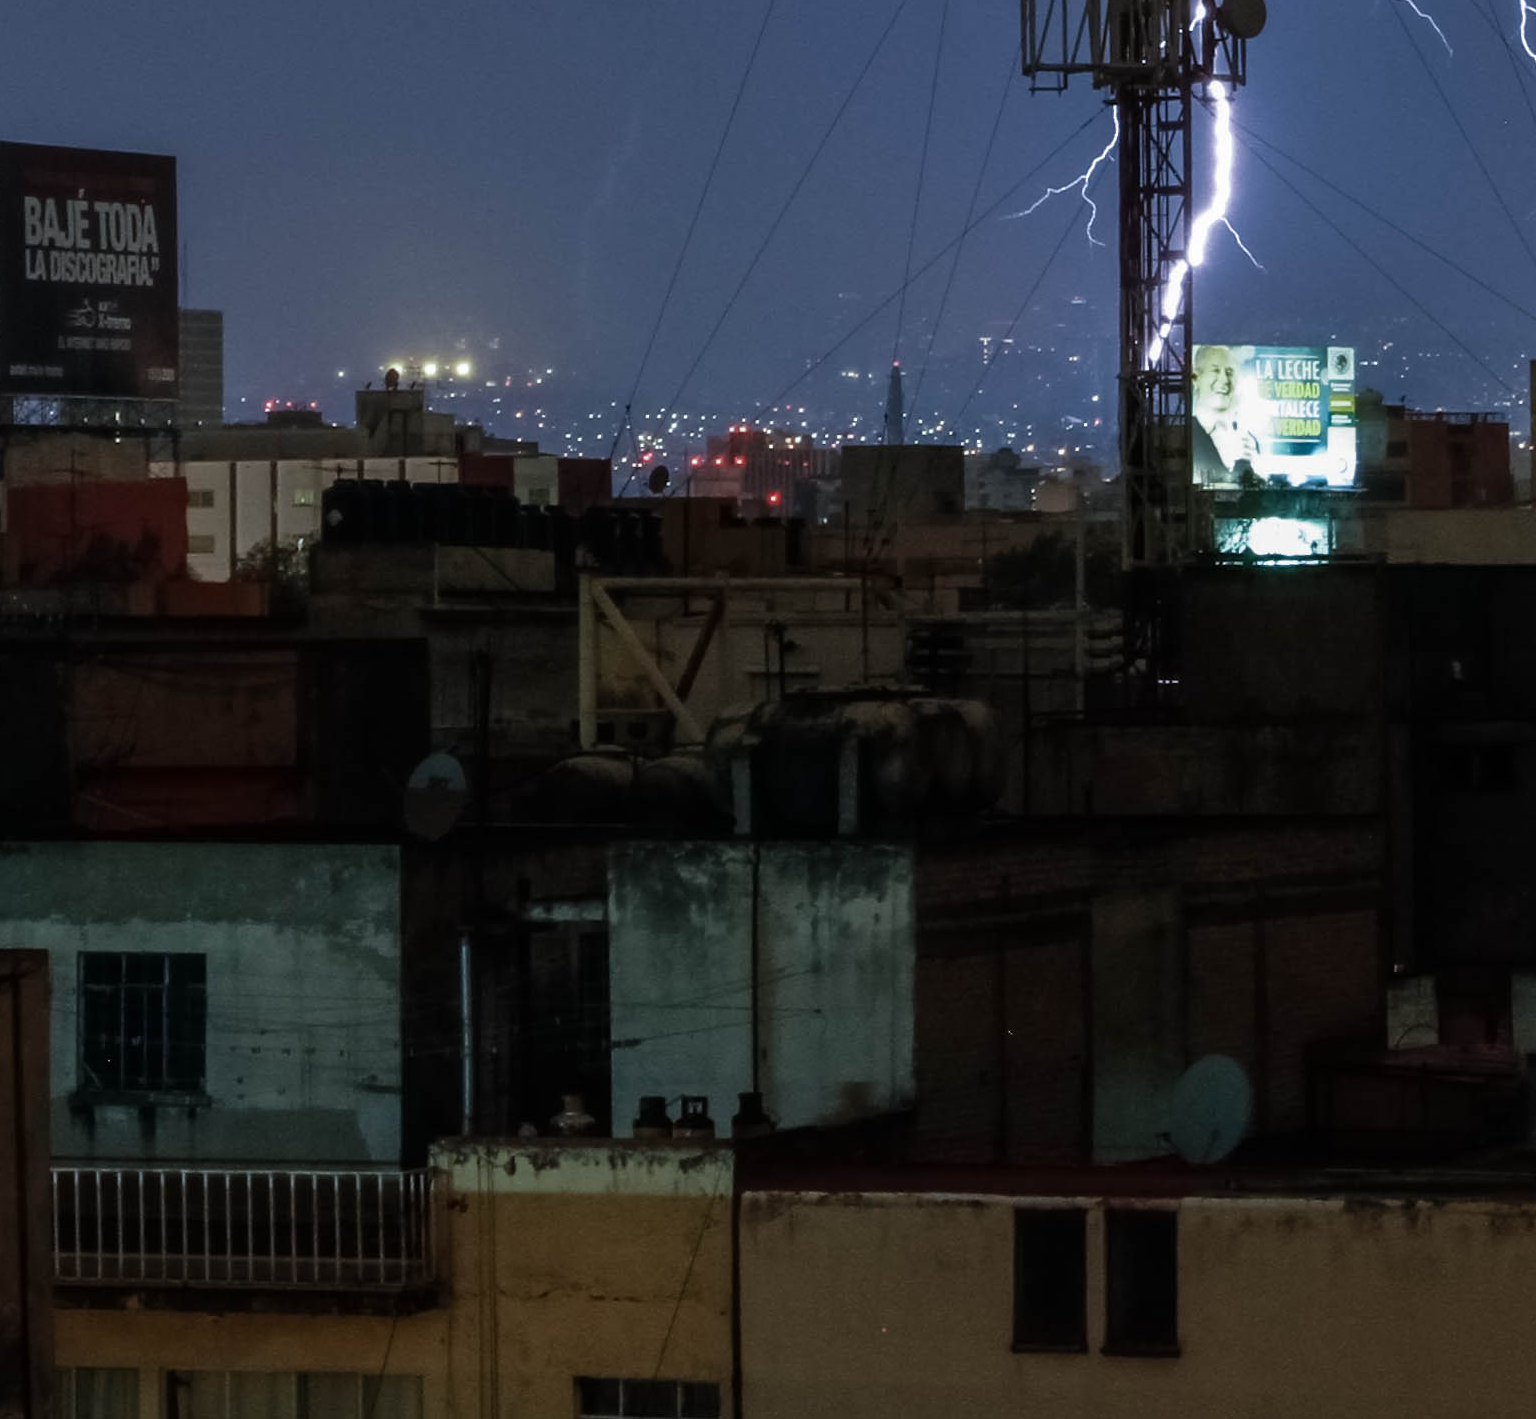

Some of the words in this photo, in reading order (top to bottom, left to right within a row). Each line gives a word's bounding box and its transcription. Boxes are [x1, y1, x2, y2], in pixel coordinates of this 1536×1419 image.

[24, 188, 91, 249] BAJÉ
[94, 201, 159, 253] TODA
[25, 249, 46, 280] LA
[1256, 359, 1273, 379] LA
[1277, 360, 1320, 380] LECHE
[1274, 381, 1320, 398] VERDAD
[1274, 419, 1321, 435] VERDAD
